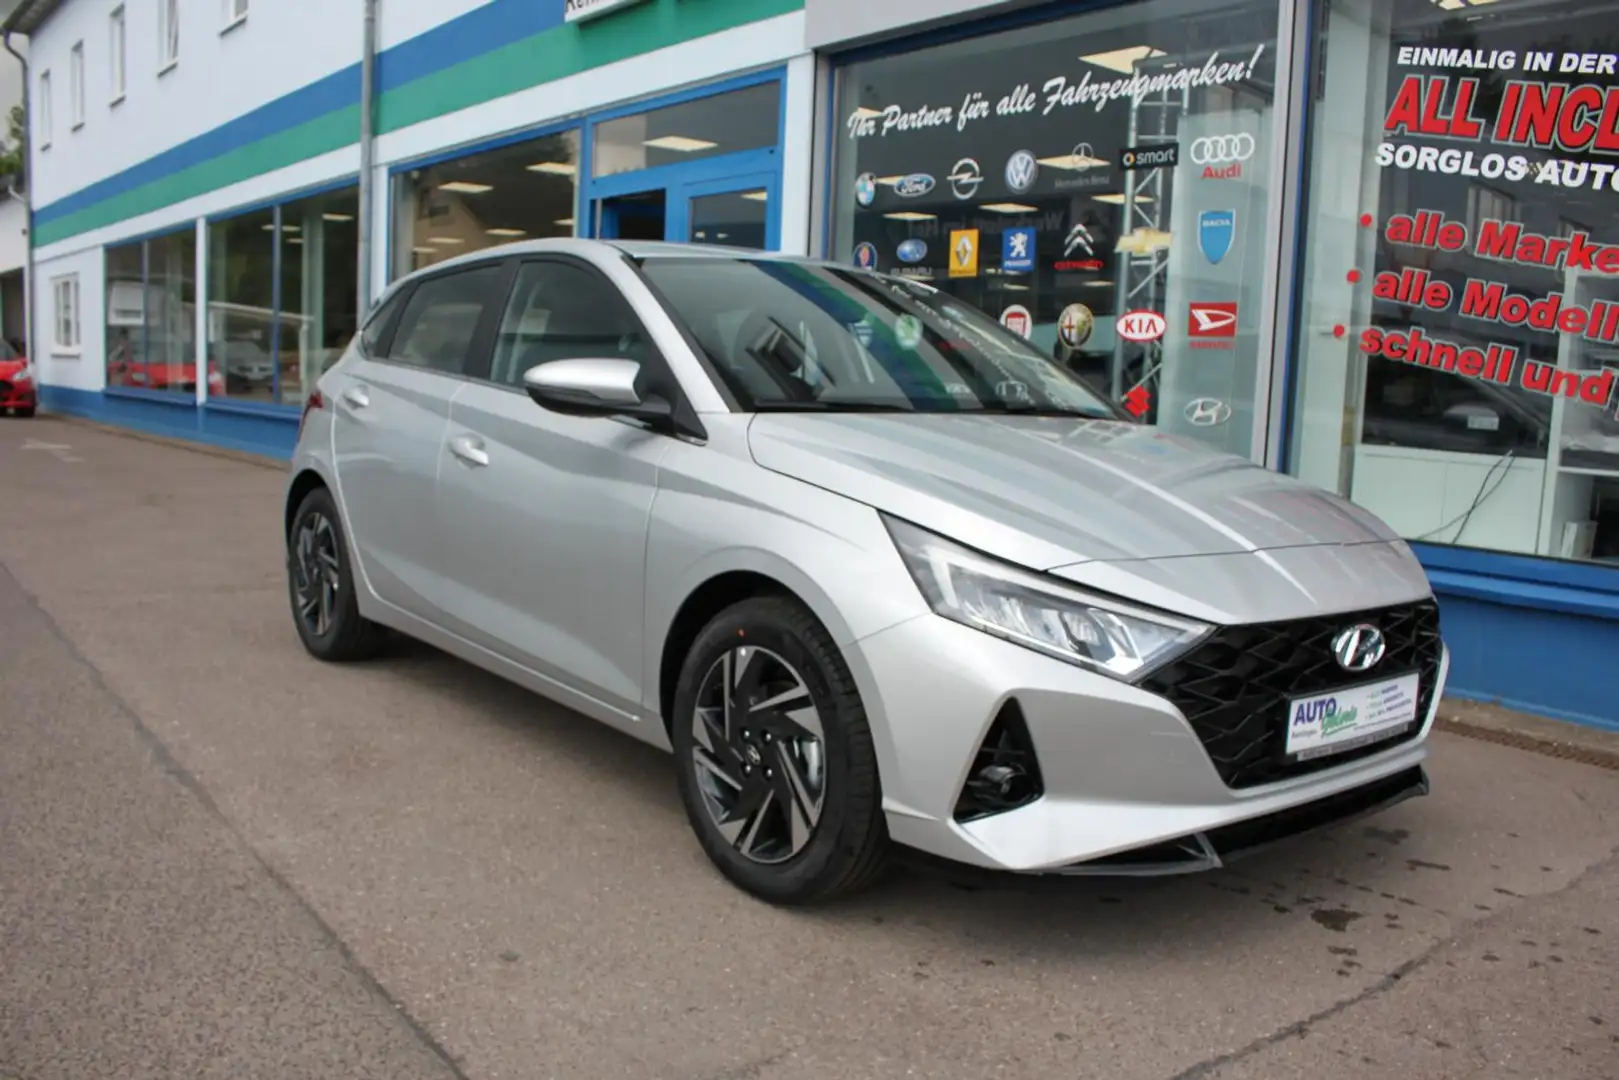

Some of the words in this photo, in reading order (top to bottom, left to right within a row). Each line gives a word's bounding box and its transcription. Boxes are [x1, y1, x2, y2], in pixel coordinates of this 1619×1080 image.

[1397, 46, 1516, 70] EINMALIG
[1523, 51, 1553, 72] IN
[1559, 52, 1617, 75] DER
[847, 111, 876, 139] Ihr
[881, 104, 953, 137] Partner
[957, 92, 990, 132] für
[996, 83, 1037, 116] alle
[1042, 43, 1265, 116] Fahrzeugmarken!
[1383, 74, 1486, 142] ALL
[1136, 149, 1175, 166] smart
[1202, 163, 1242, 180] Audi
[1374, 142, 1529, 181] SORGLOS
[1385, 208, 1468, 252] alle
[1372, 266, 1453, 312] alle
[1124, 319, 1157, 334] KIA
[1359, 325, 1518, 387] schnell
[1520, 358, 1618, 411] und
[1293, 697, 1337, 726] AUTO
